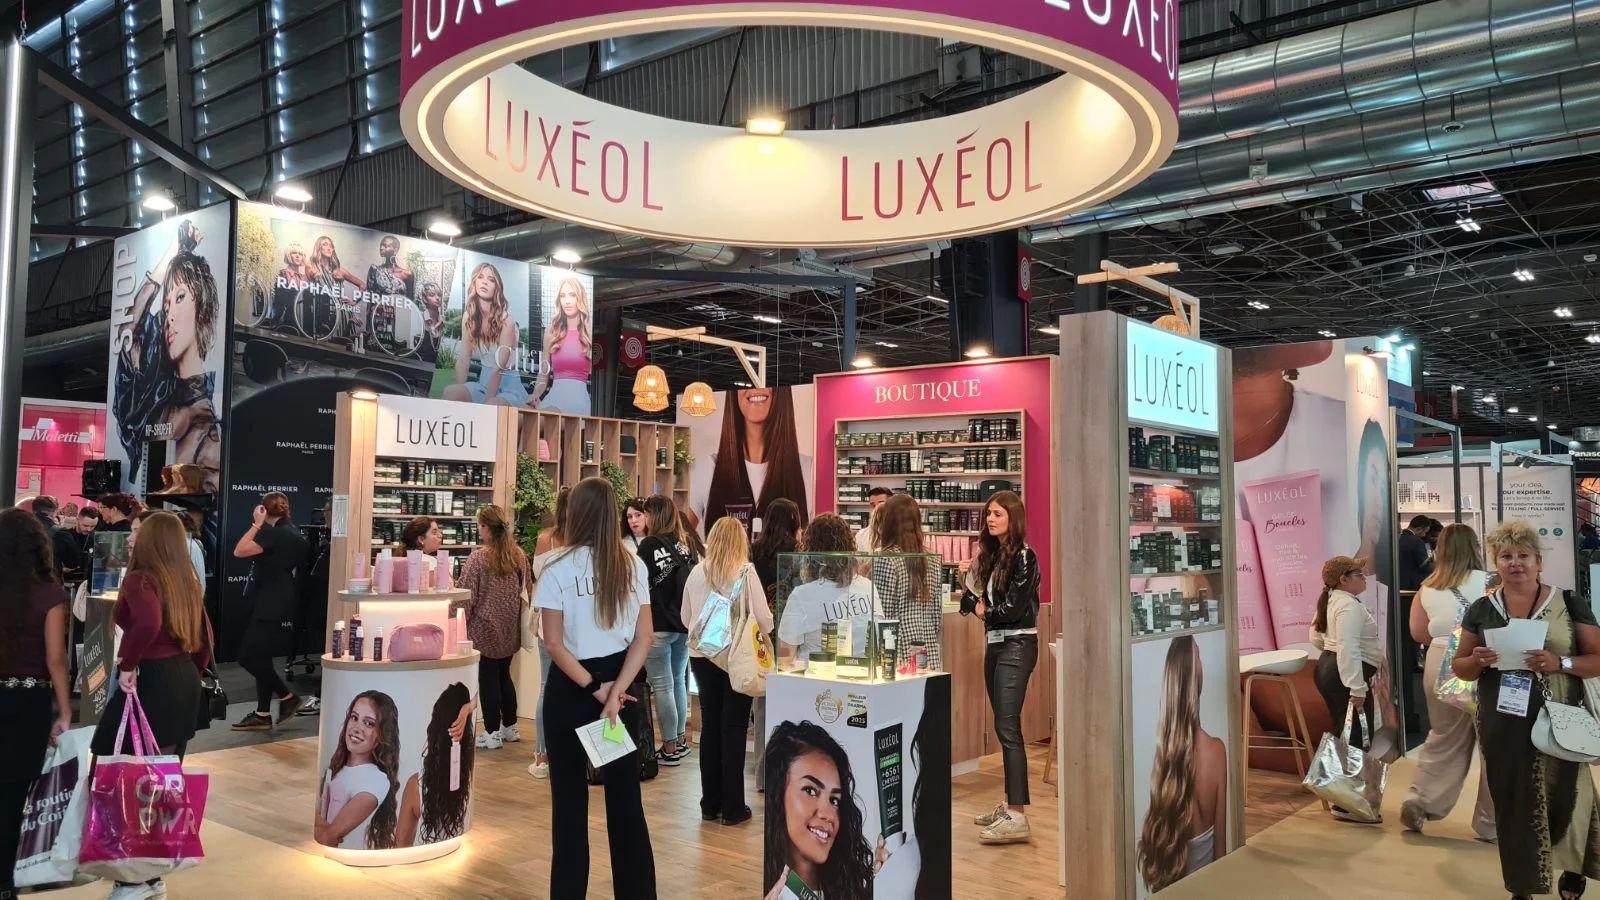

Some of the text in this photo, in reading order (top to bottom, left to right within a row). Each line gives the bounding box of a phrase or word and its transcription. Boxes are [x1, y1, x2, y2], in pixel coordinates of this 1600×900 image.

[485, 77, 663, 211] LUXÉOL
[841, 120, 1042, 221] LUXÉOL
[114, 244, 137, 355] SHOP
[277, 277, 413, 310] RAPHAËL PERRIER
[335, 304, 361, 314] PARIS
[875, 379, 981, 403] BOUTIQUE
[1134, 343, 1209, 415] LUXÉOL
[396, 414, 478, 449] LUXÉOL
[276, 441, 308, 449] RAPHAËL
[1264, 516, 1305, 534] Boucles
[653, 547, 671, 561] AL
[823, 593, 876, 622] LUXÉOL
[851, 716, 866, 724] 2025
[877, 731, 900, 750] LUXÉOL
